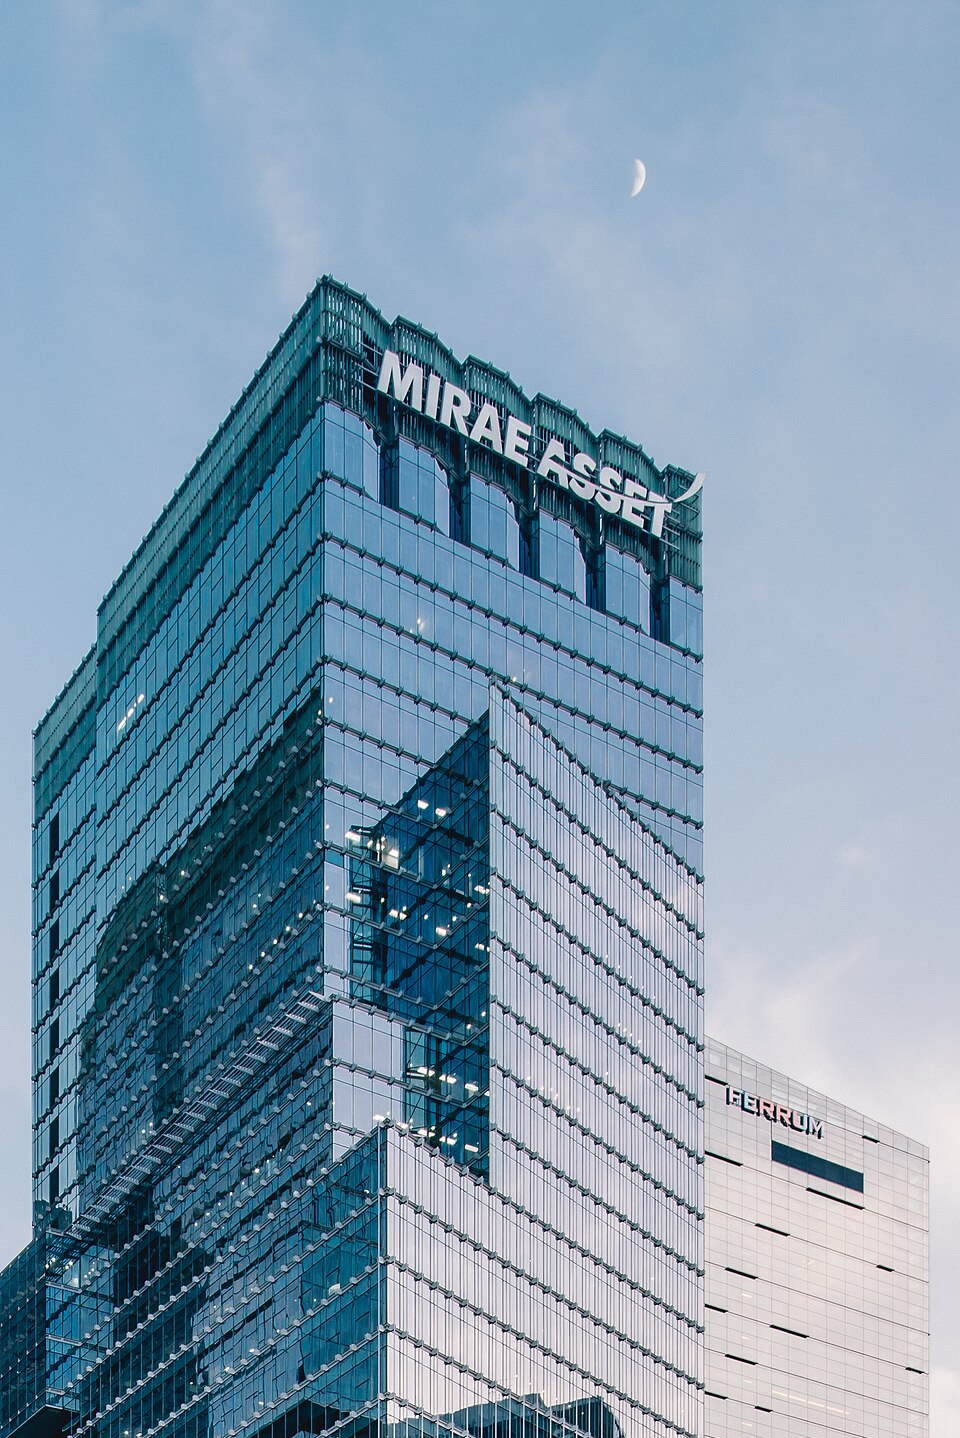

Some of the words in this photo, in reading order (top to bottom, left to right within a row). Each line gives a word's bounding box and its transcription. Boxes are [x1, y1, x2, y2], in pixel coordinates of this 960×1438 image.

[376, 349, 532, 467] MIRAE
[536, 438, 674, 538] ASSET
[725, 1085, 825, 1139] FERRUM
